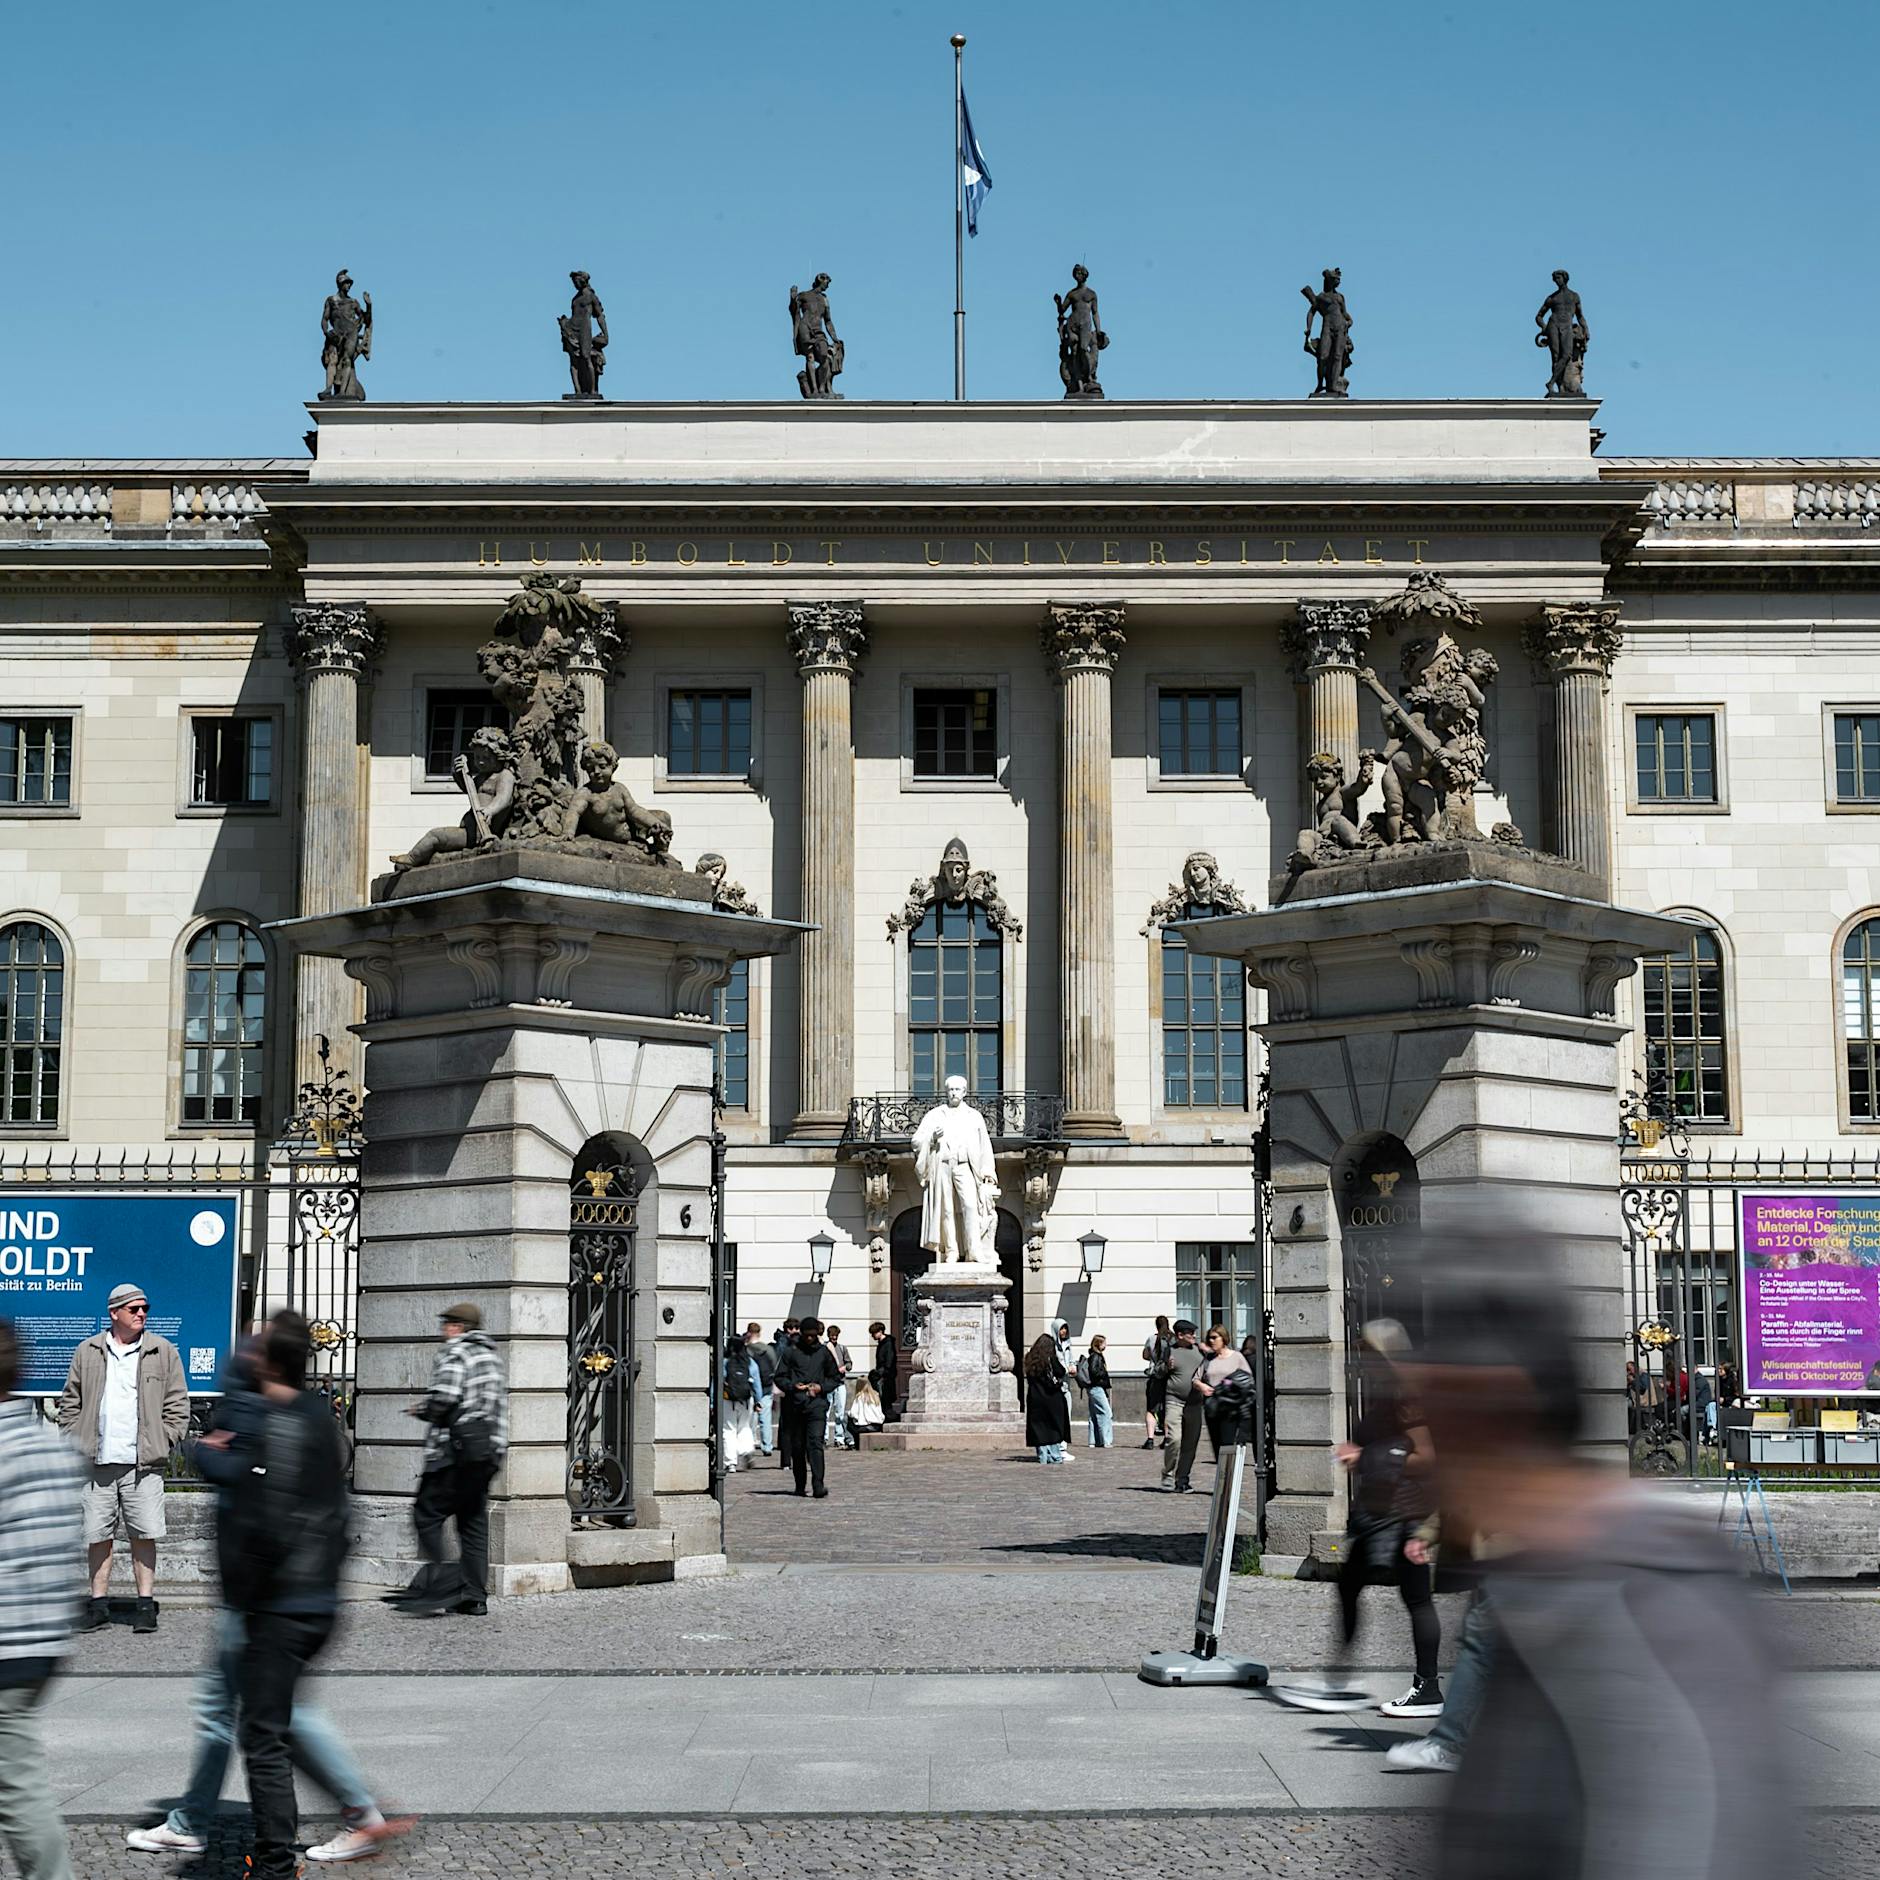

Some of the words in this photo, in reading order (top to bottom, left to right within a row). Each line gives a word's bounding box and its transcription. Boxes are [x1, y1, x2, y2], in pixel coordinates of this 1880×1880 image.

[479, 541, 842, 567] HUMBOLDT
[923, 540, 1429, 566] UNIVERSITAET
[680, 1203, 692, 1230] 6
[1756, 1207, 1814, 1219] Entdecke
[1816, 1207, 1880, 1222] Forschung
[0, 1211, 60, 1240] IND
[1757, 1221, 1812, 1234] Material,
[1814, 1221, 1857, 1235] Design
[1757, 1236, 1773, 1247] an
[1775, 1235, 1790, 1247] 12
[1792, 1235, 1829, 1247] Orten
[1830, 1235, 1850, 1247] der
[0, 1246, 94, 1276] OLDT
[27, 1281, 42, 1291] zu
[46, 1278, 83, 1291] Berlin
[1759, 1280, 1797, 1288] Co-Design
[1776, 1287, 1818, 1295] Ausstellung
[1839, 1287, 1861, 1295] Spree
[1823, 1328, 1846, 1337] Finger
[1761, 1360, 1862, 1369] Wissenschaftsfestival
[1762, 1371, 1783, 1382] April
[1785, 1371, 1799, 1380] bis
[1800, 1371, 1838, 1380] Oktober
[1839, 1371, 1865, 1380] 2025
